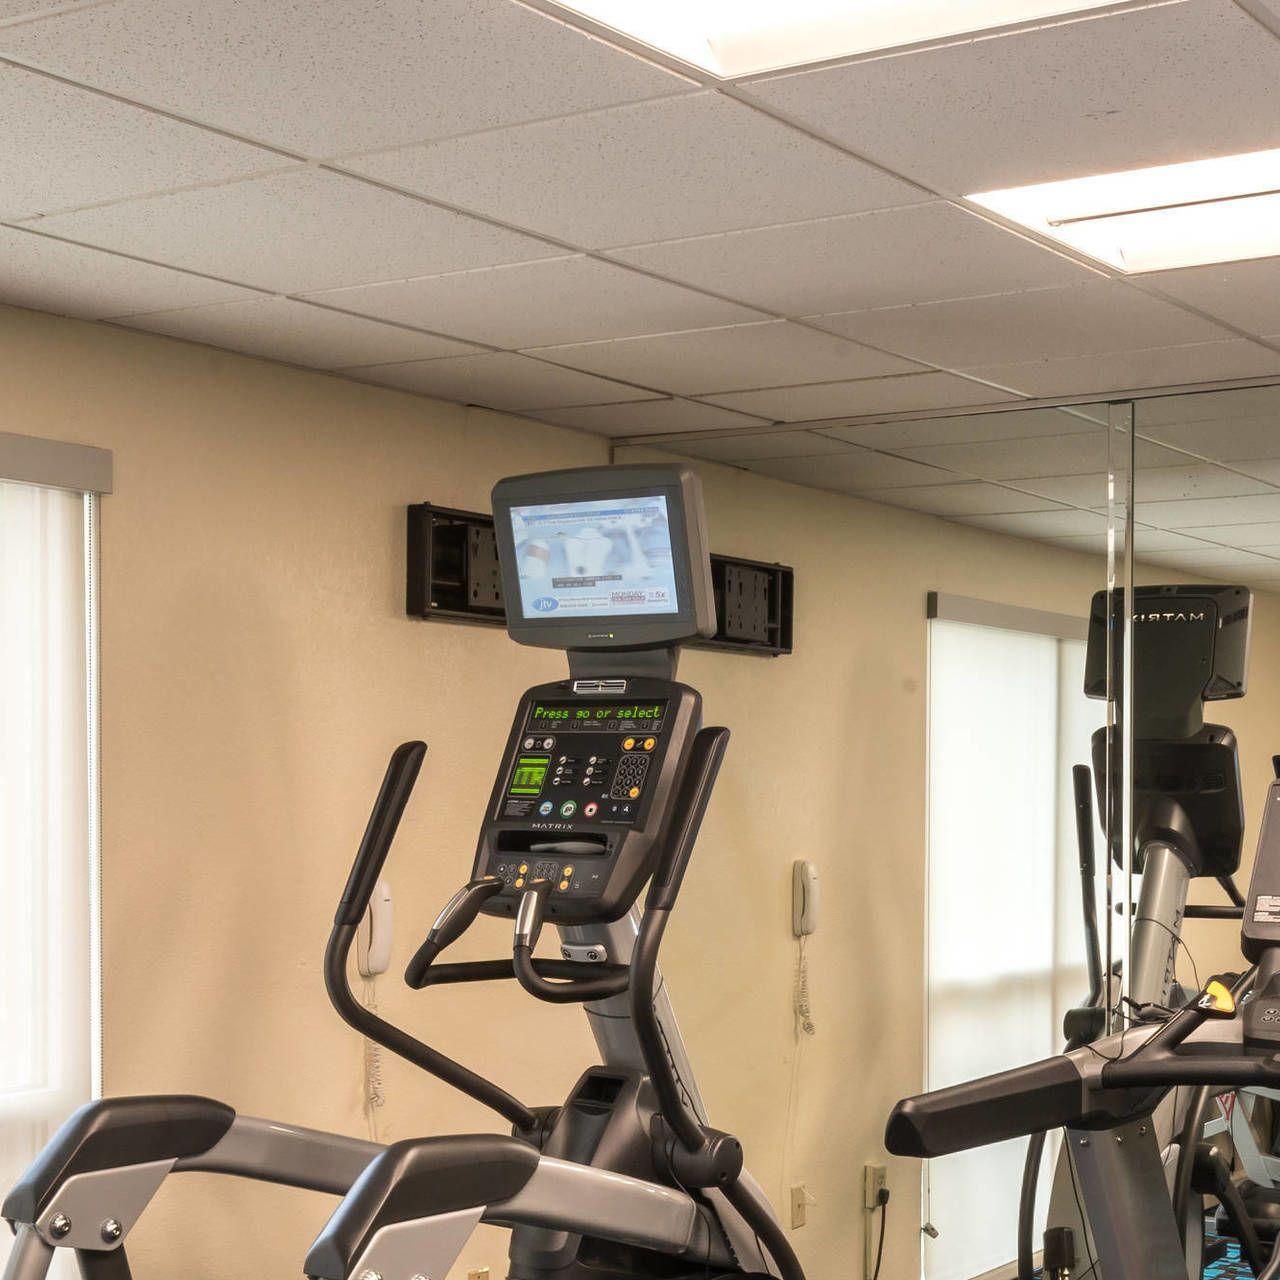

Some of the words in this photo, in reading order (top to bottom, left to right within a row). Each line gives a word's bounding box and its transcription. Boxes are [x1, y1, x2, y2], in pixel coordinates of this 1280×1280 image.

[534, 706, 569, 719] Press
[596, 709, 611, 719] or
[616, 705, 661, 719] select
